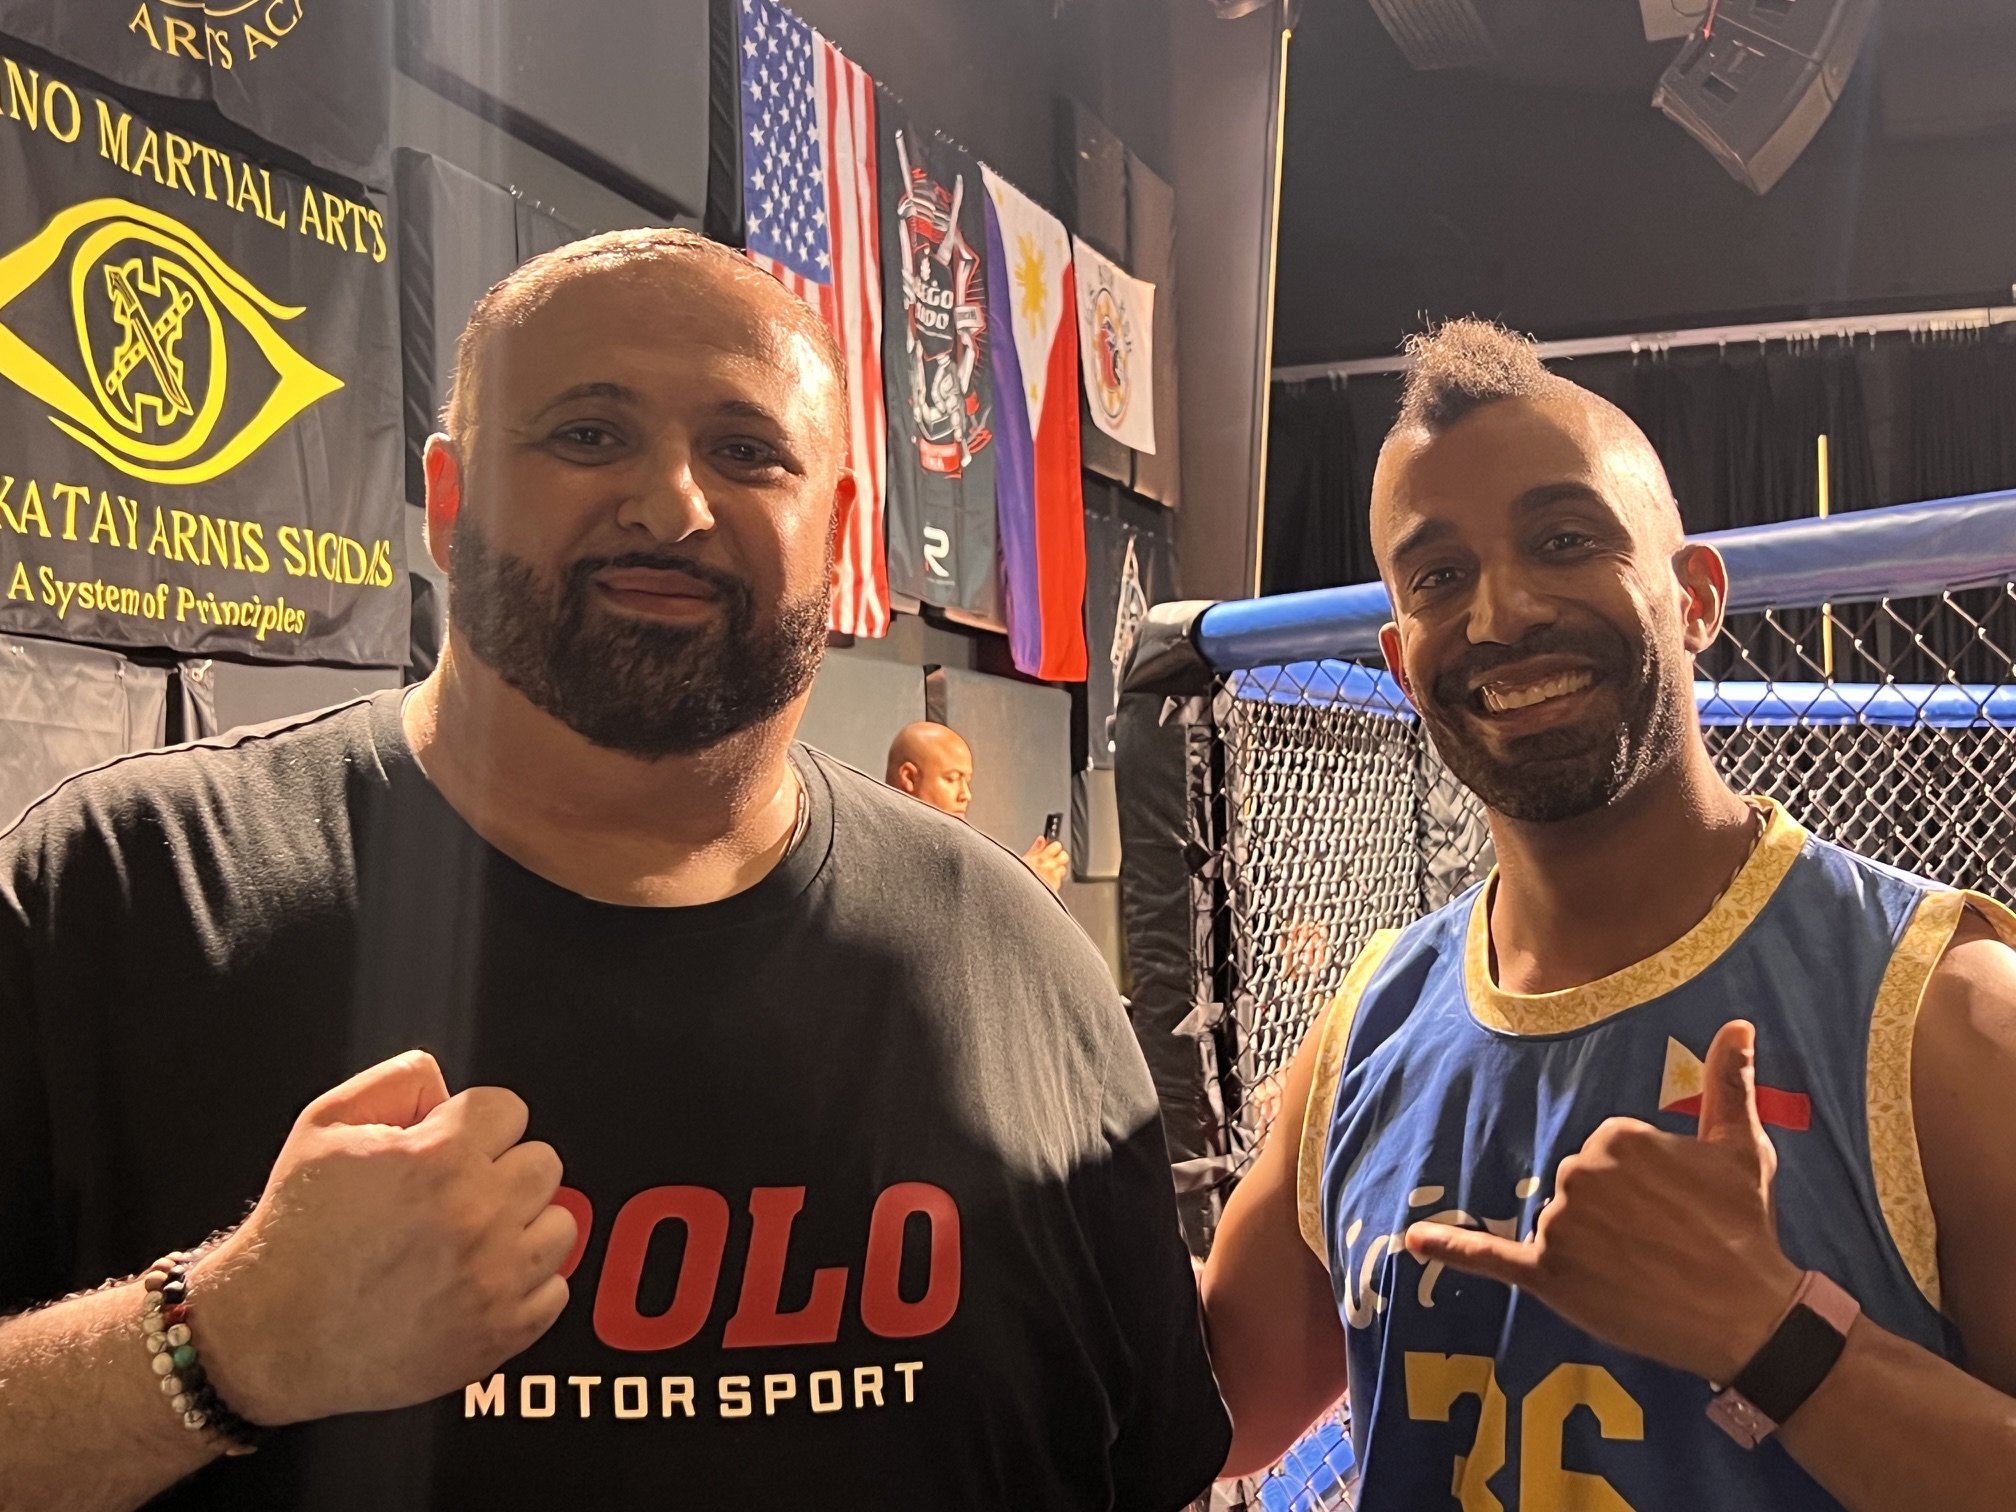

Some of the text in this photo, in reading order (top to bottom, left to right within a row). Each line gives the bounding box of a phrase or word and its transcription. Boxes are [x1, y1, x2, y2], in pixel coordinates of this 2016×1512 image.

[0, 56, 388, 264] NO MARTIAL ARTS
[147, 504, 272, 575] ARNIS
[7, 561, 306, 642] A System of Principles
